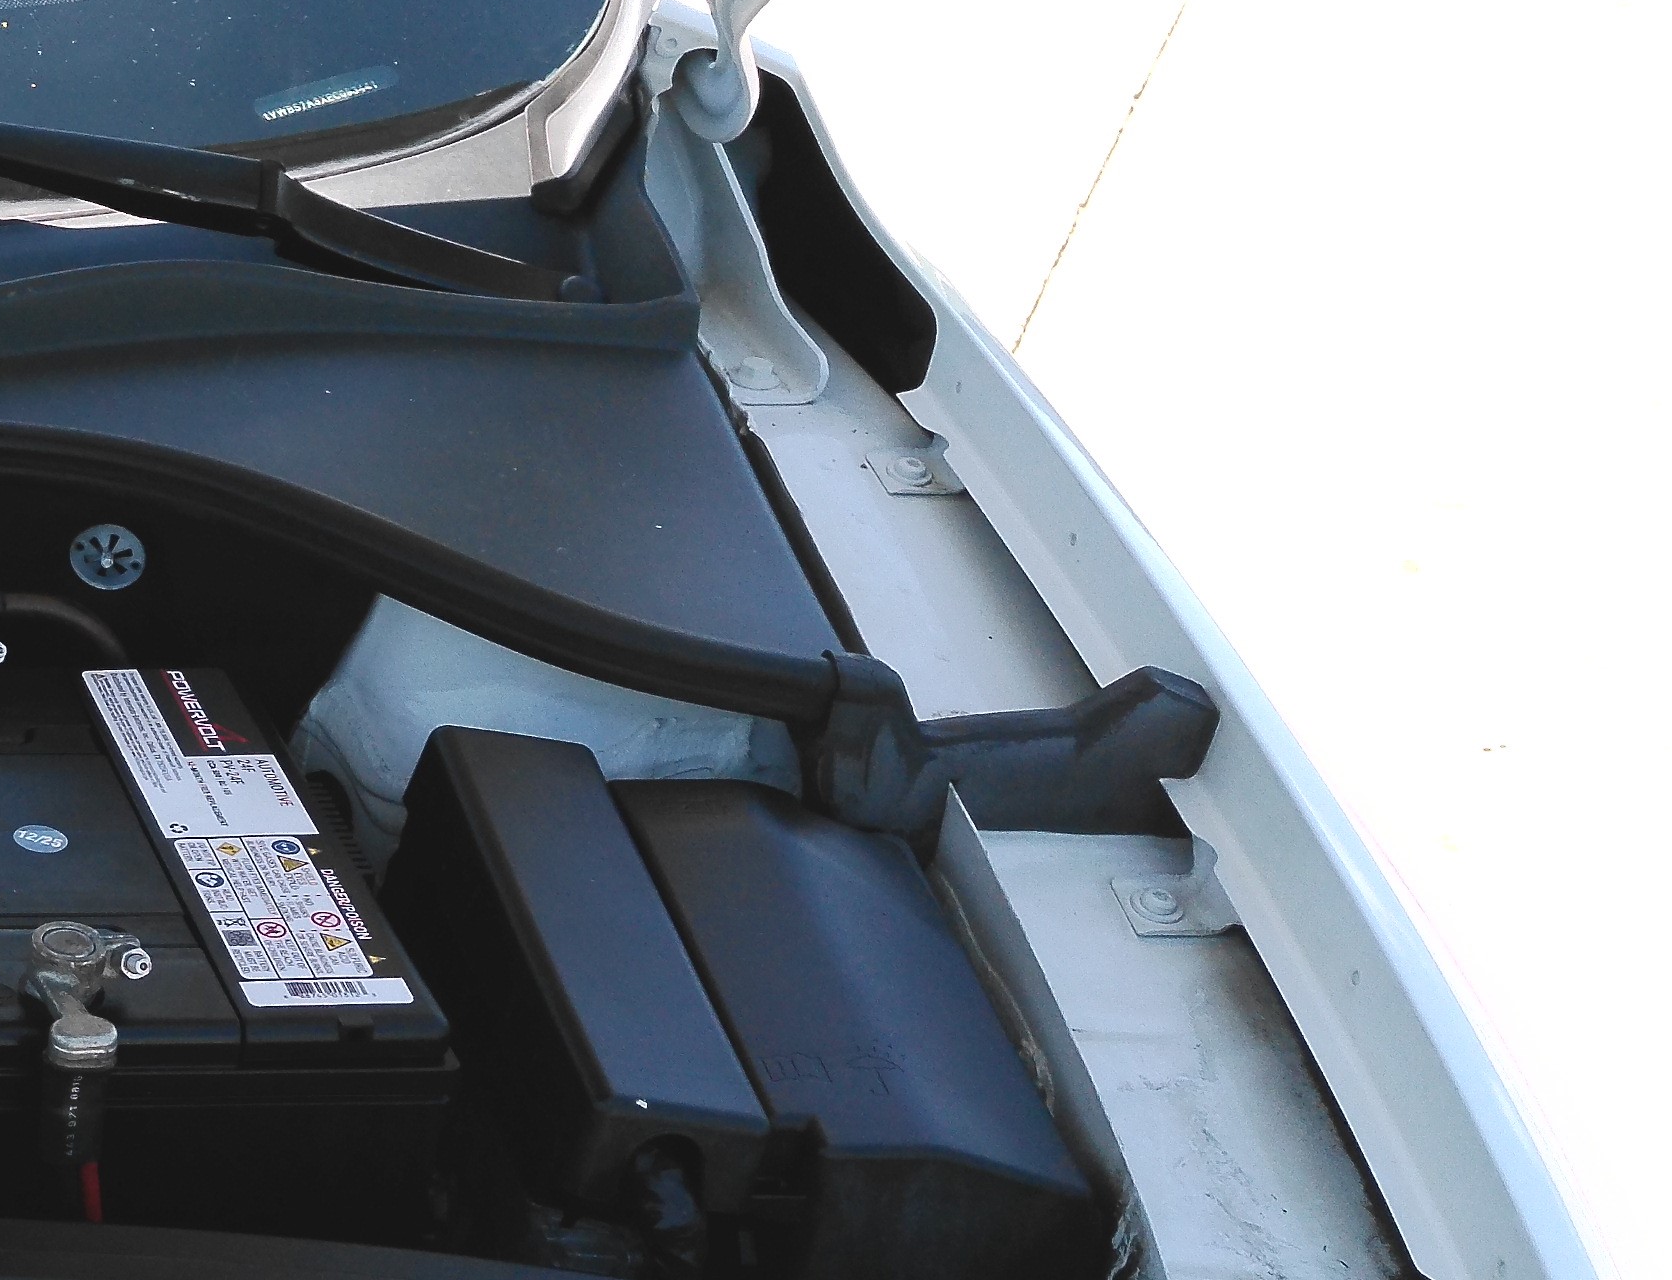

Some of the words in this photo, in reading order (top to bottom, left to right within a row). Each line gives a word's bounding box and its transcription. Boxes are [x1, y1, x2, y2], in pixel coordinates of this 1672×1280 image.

[165, 670, 227, 753] POWERVOLT
[218, 759, 245, 785] PV-24F
[235, 758, 256, 773] 24F
[254, 758, 294, 806] AUTOMOTIVE
[17, 829, 64, 848] 12/25
[319, 868, 373, 940] DANGER/POISON
